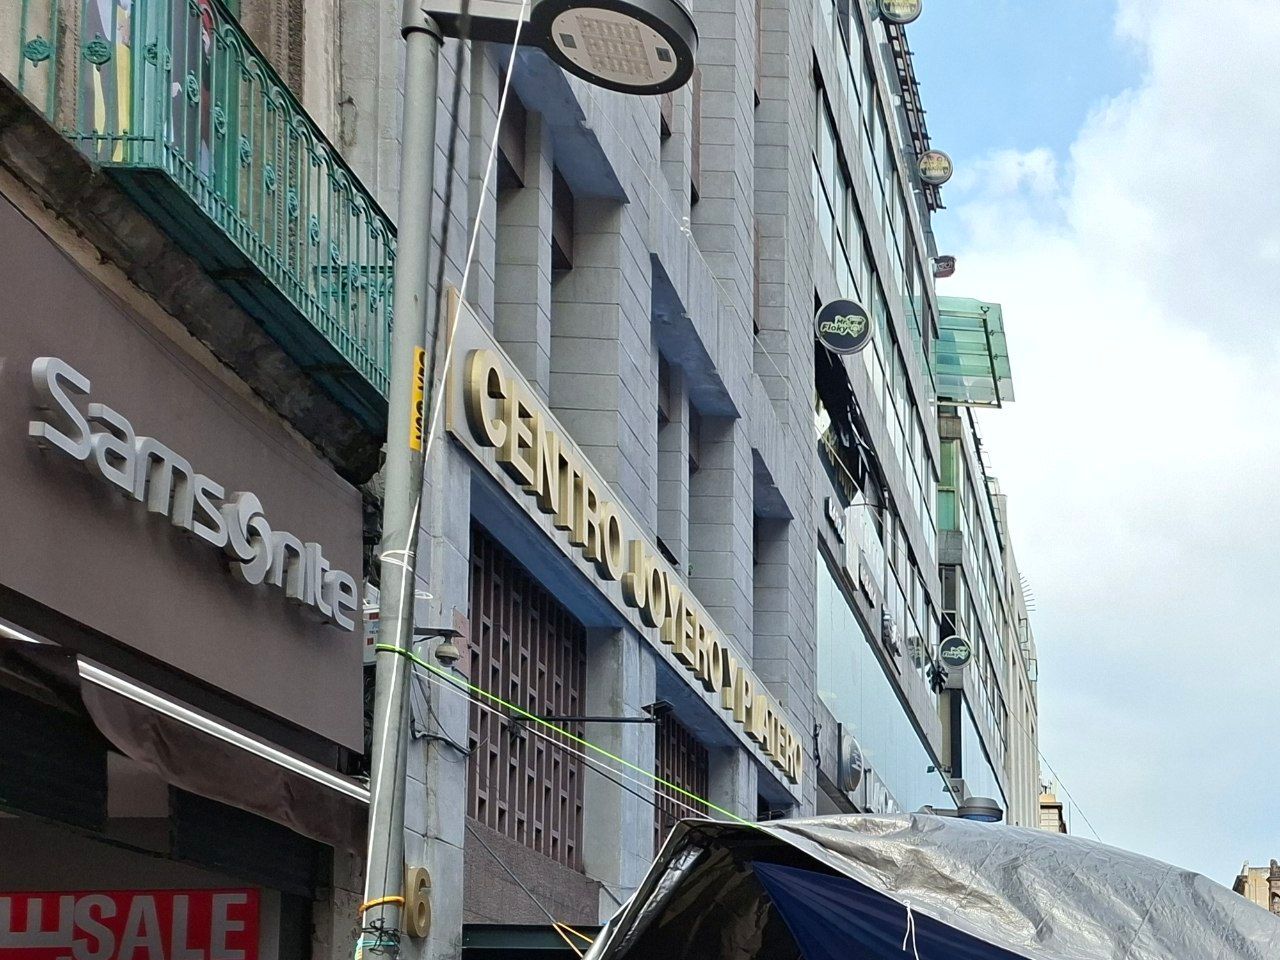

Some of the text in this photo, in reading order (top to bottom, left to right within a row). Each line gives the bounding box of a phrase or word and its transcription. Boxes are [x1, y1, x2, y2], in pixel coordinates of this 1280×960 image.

[821, 323, 849, 333] Floky
[29, 356, 357, 631] Samsonite
[464, 349, 624, 581] CENTRO
[621, 539, 723, 693] JOYERO
[733, 667, 804, 784] PLATERO
[406, 867, 432, 938] 6
